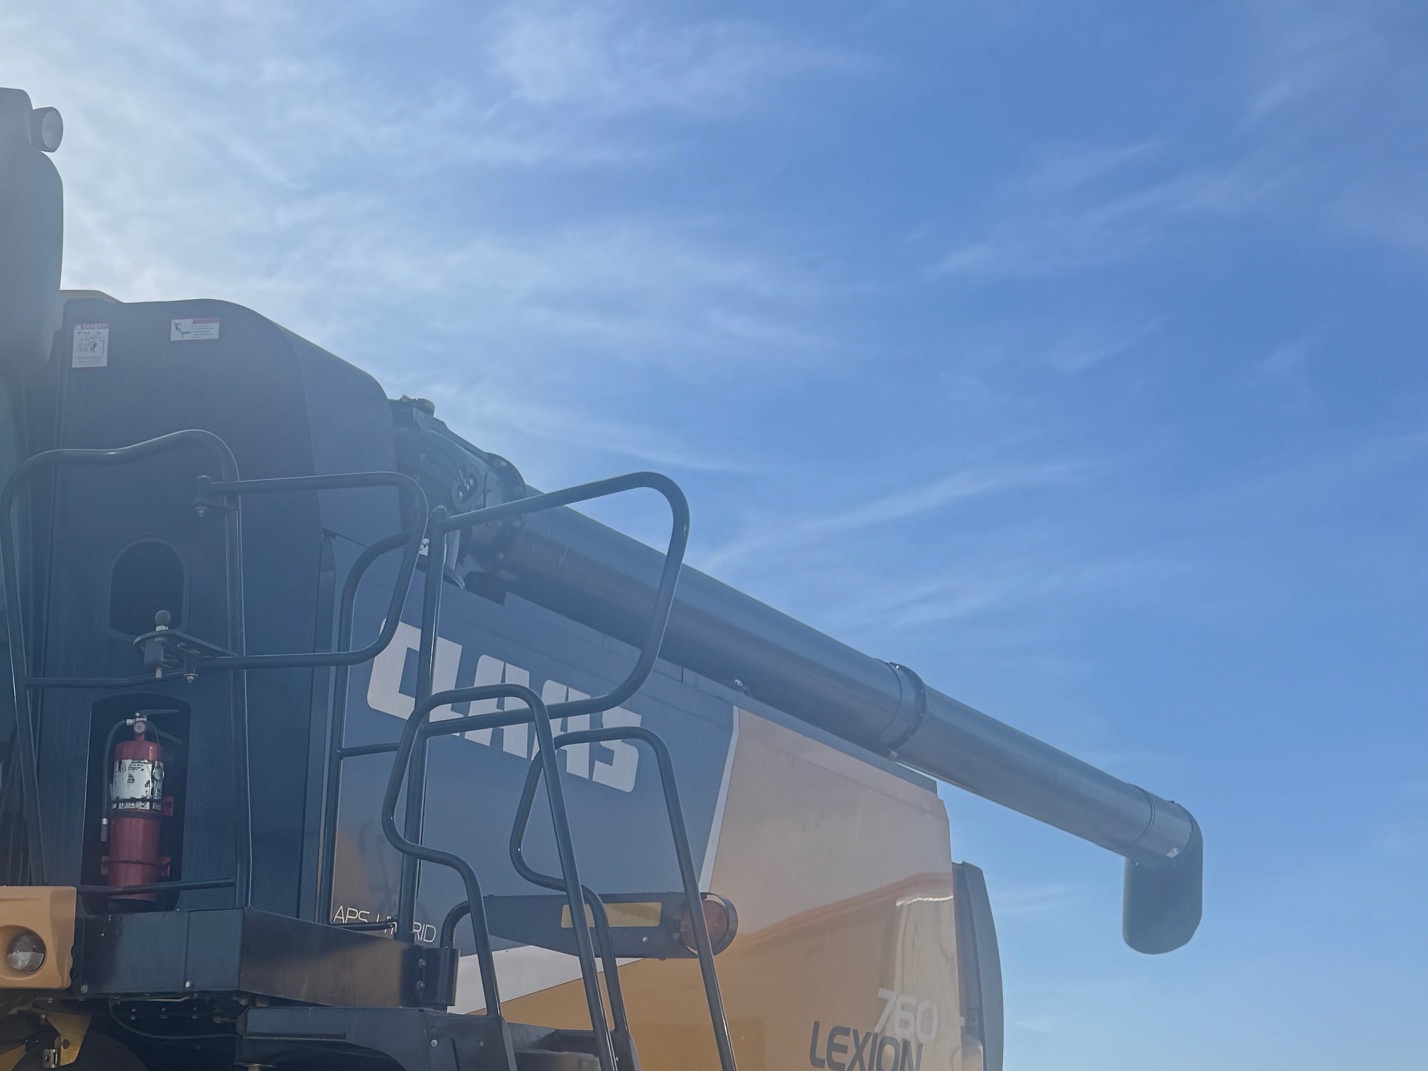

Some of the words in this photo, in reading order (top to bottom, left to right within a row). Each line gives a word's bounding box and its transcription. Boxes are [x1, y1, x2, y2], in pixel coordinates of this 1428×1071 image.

[367, 617, 642, 793] CLAAS
[333, 905, 371, 924] APS
[874, 987, 939, 1042] 760
